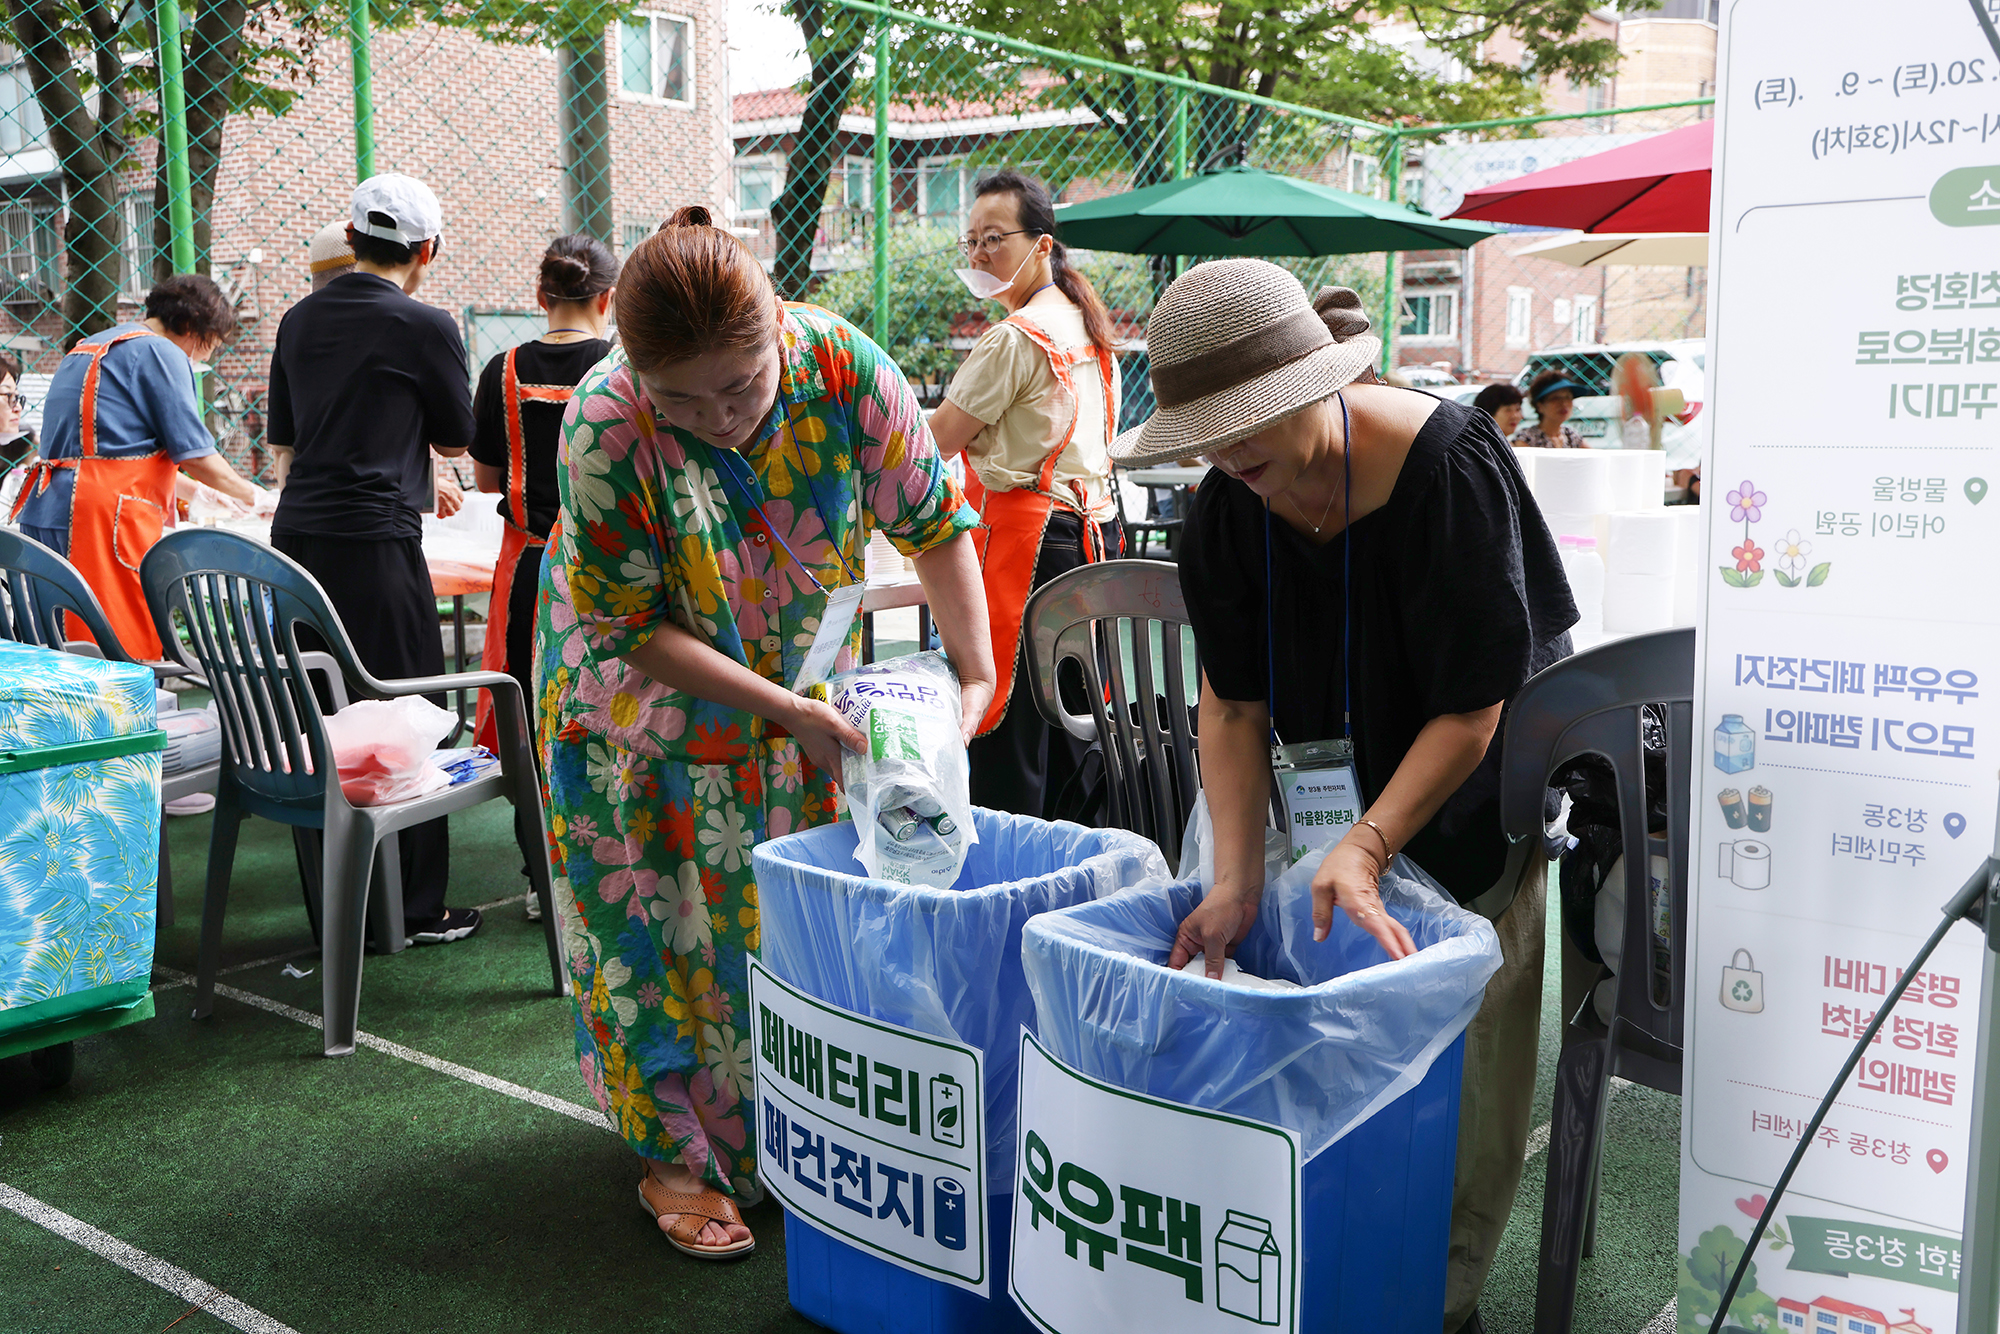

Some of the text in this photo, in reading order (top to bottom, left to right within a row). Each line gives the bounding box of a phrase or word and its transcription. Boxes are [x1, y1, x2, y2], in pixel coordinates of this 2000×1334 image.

[1295, 809, 1354, 826] 마을환경분과
[759, 1001, 921, 1136] 폐배터리
[763, 1096, 925, 1238] 폐건전지
[1022, 1129, 1204, 1303] 우유팩
